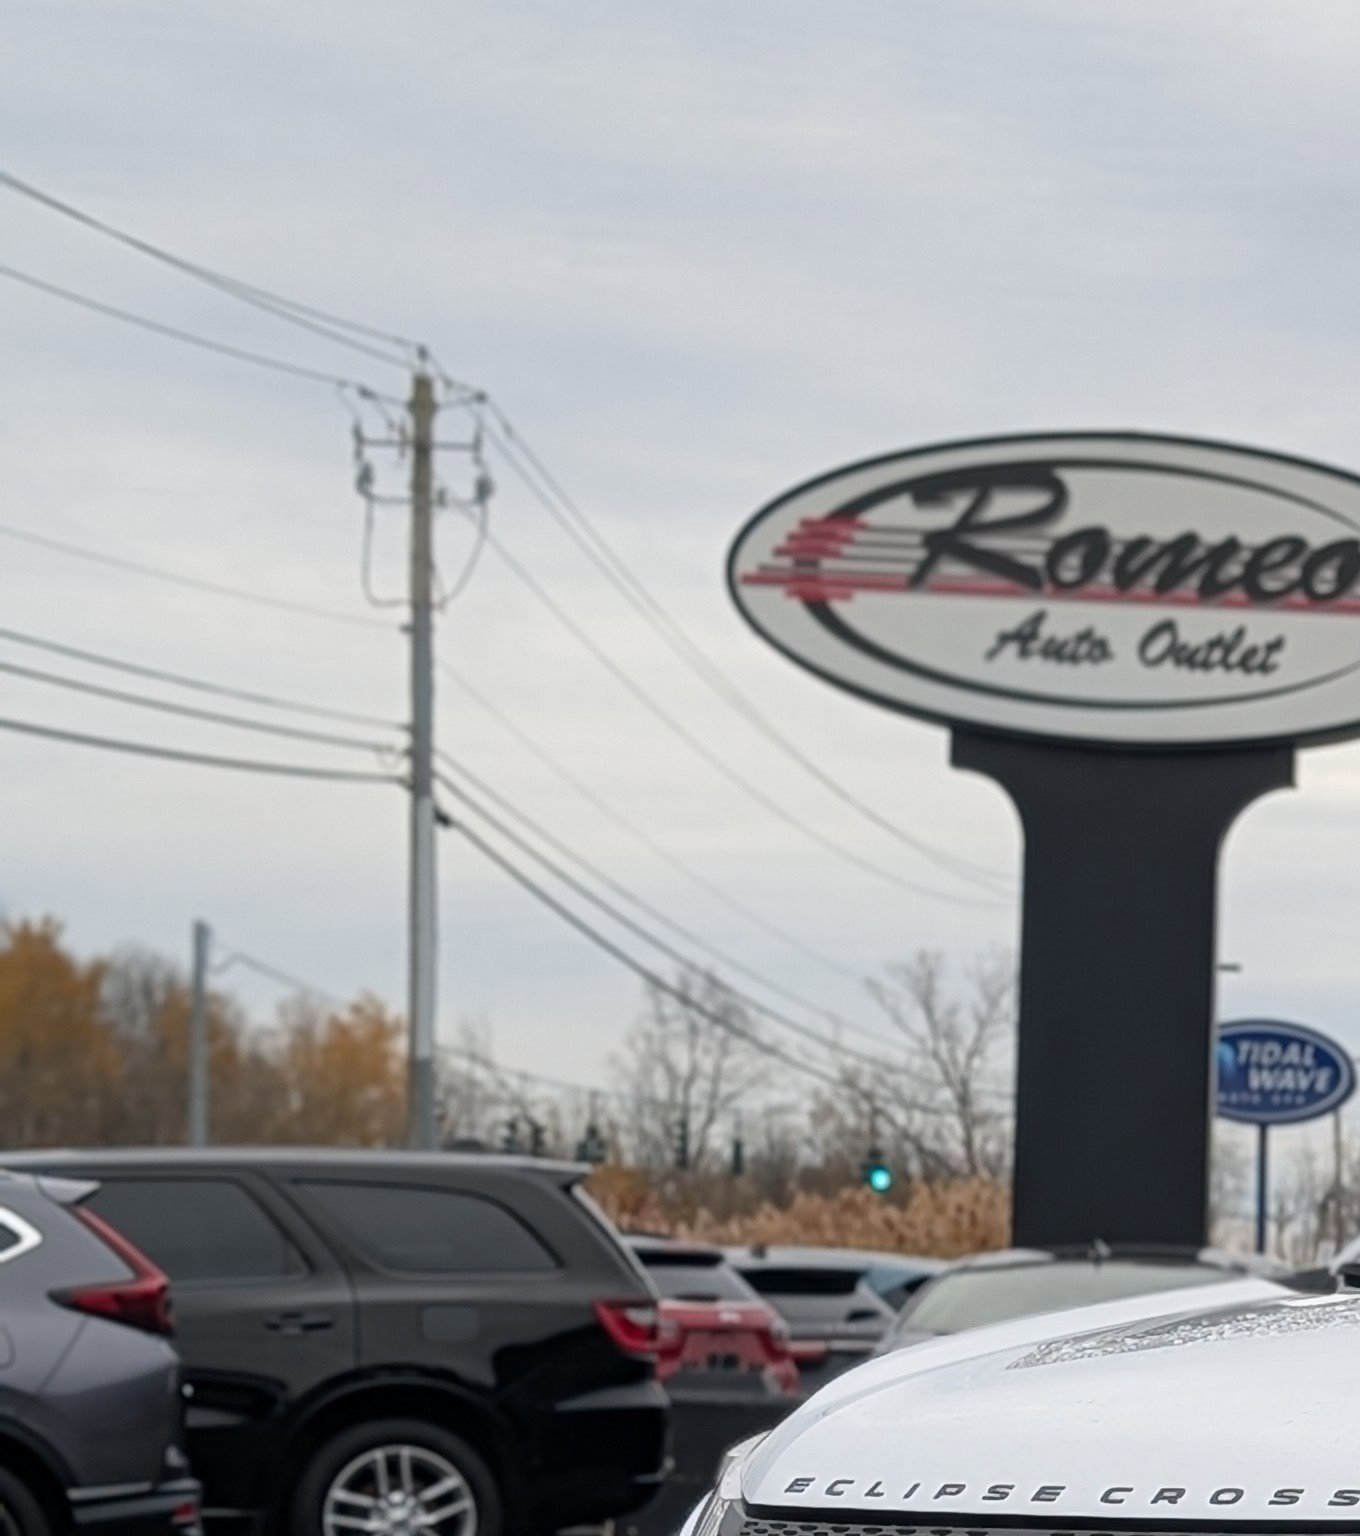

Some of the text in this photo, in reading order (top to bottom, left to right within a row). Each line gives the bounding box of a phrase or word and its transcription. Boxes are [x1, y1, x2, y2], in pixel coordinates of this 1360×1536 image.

[985, 609, 1286, 676] Auto Outlet
[1248, 1066, 1332, 1093] WAVE
[784, 1476, 1066, 1502] ECLIPSE
